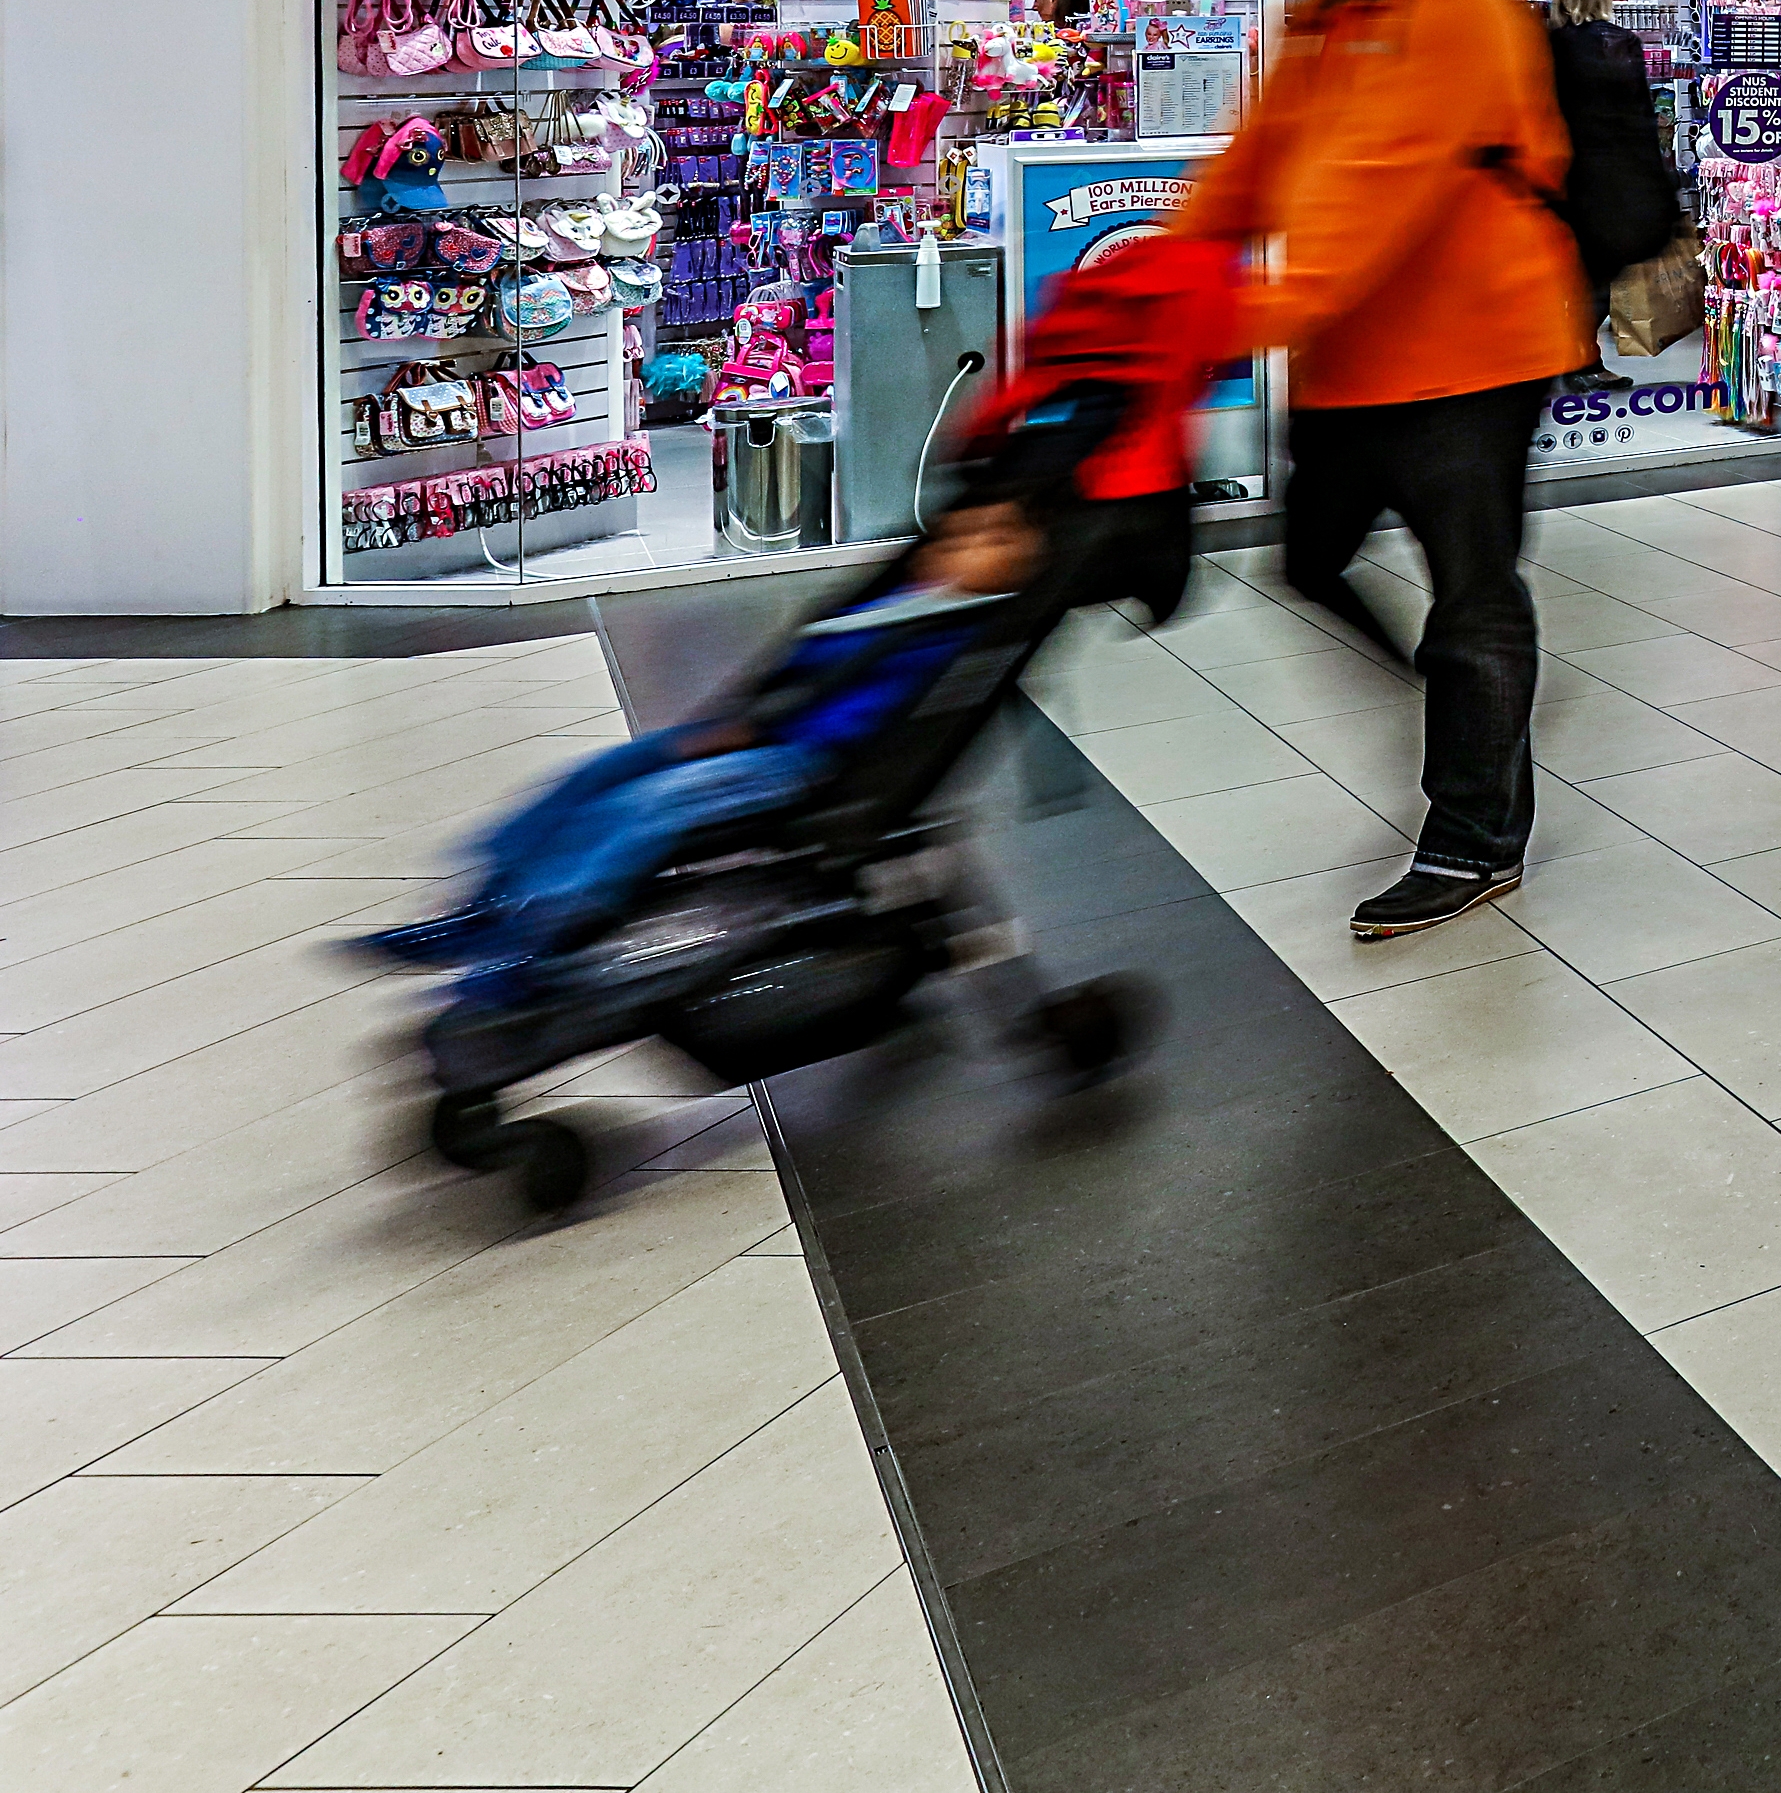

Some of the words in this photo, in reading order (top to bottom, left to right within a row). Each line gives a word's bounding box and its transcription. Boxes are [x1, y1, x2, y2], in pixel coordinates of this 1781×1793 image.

[654, 12, 671, 20] £4.50
[1195, 36, 1234, 44] EARRINGS
[663, 68, 672, 76] £3
[689, 67, 698, 75] £3
[1742, 77, 1767, 86] NUS
[1729, 87, 1779, 97] STUDENT
[1087, 183, 1114, 199] 100
[1119, 180, 1194, 195] MILLION
[1089, 197, 1126, 212] Ears
[1550, 380, 1729, 426] es.com
